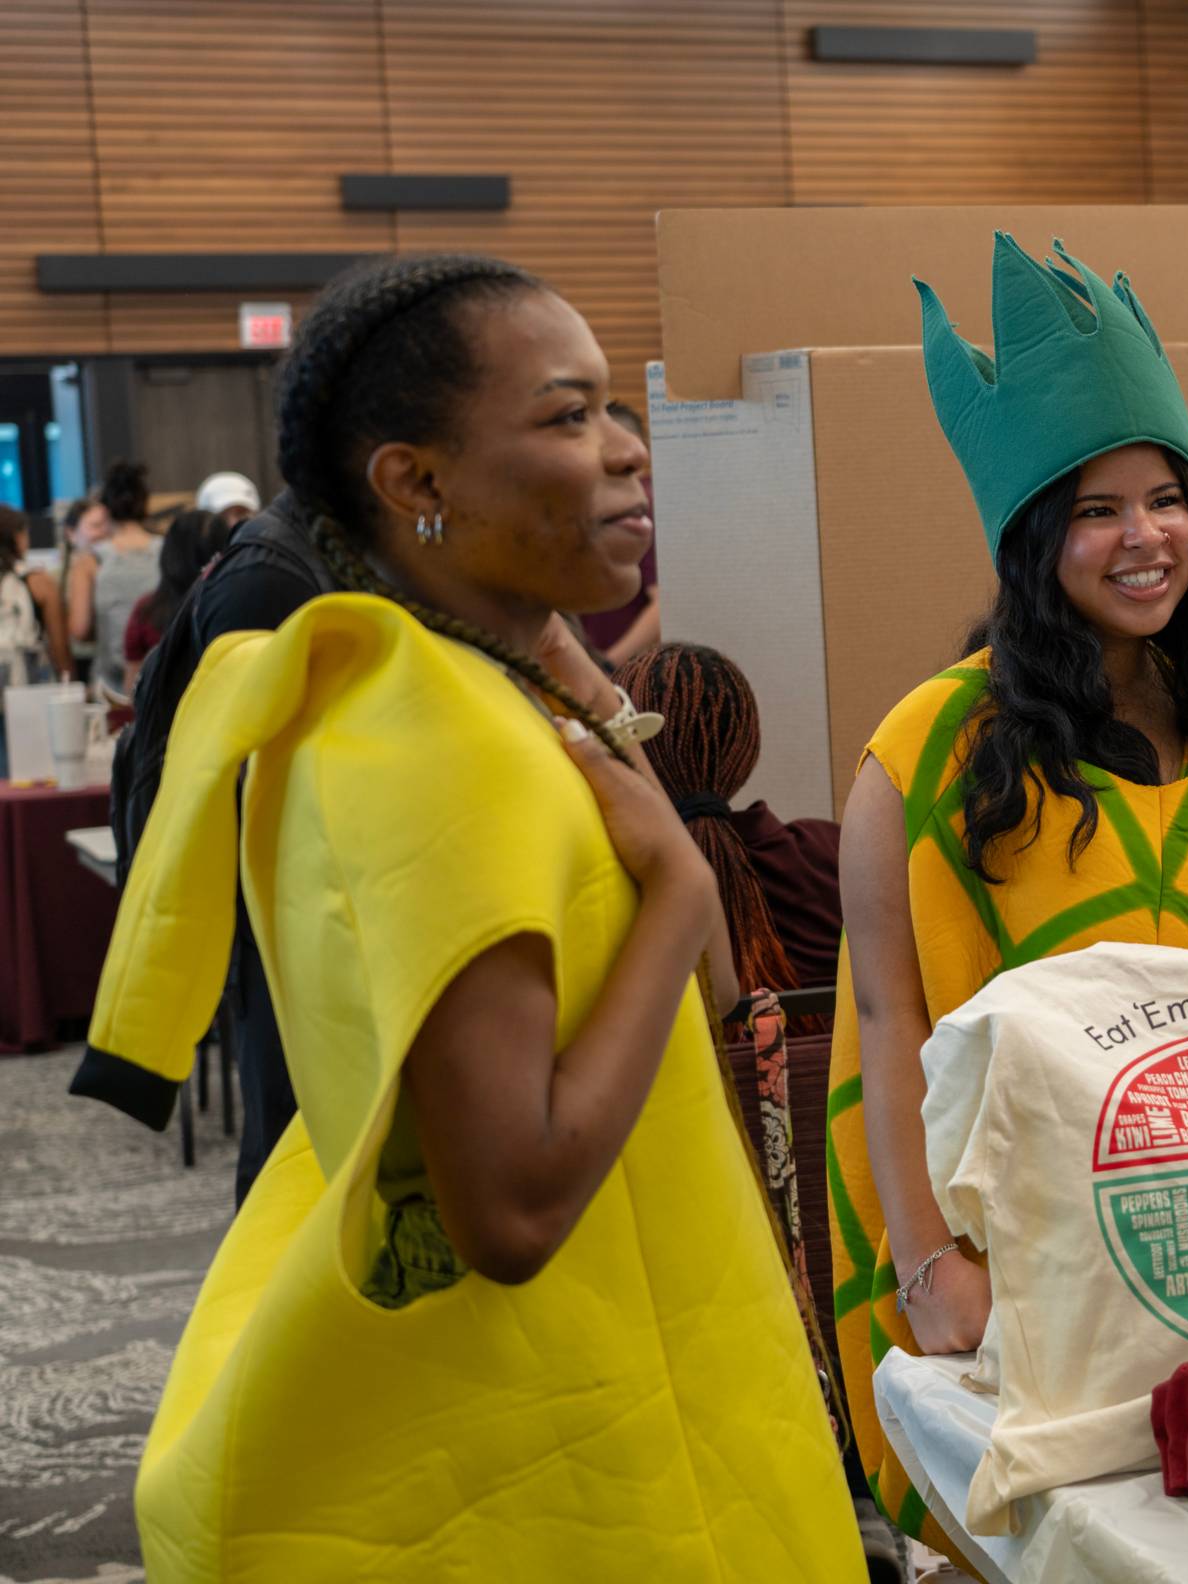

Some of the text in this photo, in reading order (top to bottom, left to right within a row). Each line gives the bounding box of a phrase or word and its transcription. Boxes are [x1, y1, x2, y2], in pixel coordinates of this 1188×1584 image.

[1083, 1014, 1137, 1051] Eat
[1145, 1072, 1174, 1086] PEACH
[1127, 1091, 1172, 1107] APRICOT
[1117, 1113, 1147, 1126] GRAPES
[1145, 1105, 1181, 1147] LIME
[1114, 1125, 1151, 1151] KIWI
[1120, 1190, 1172, 1215] PEPPERS
[1131, 1210, 1173, 1231] SPINACH
